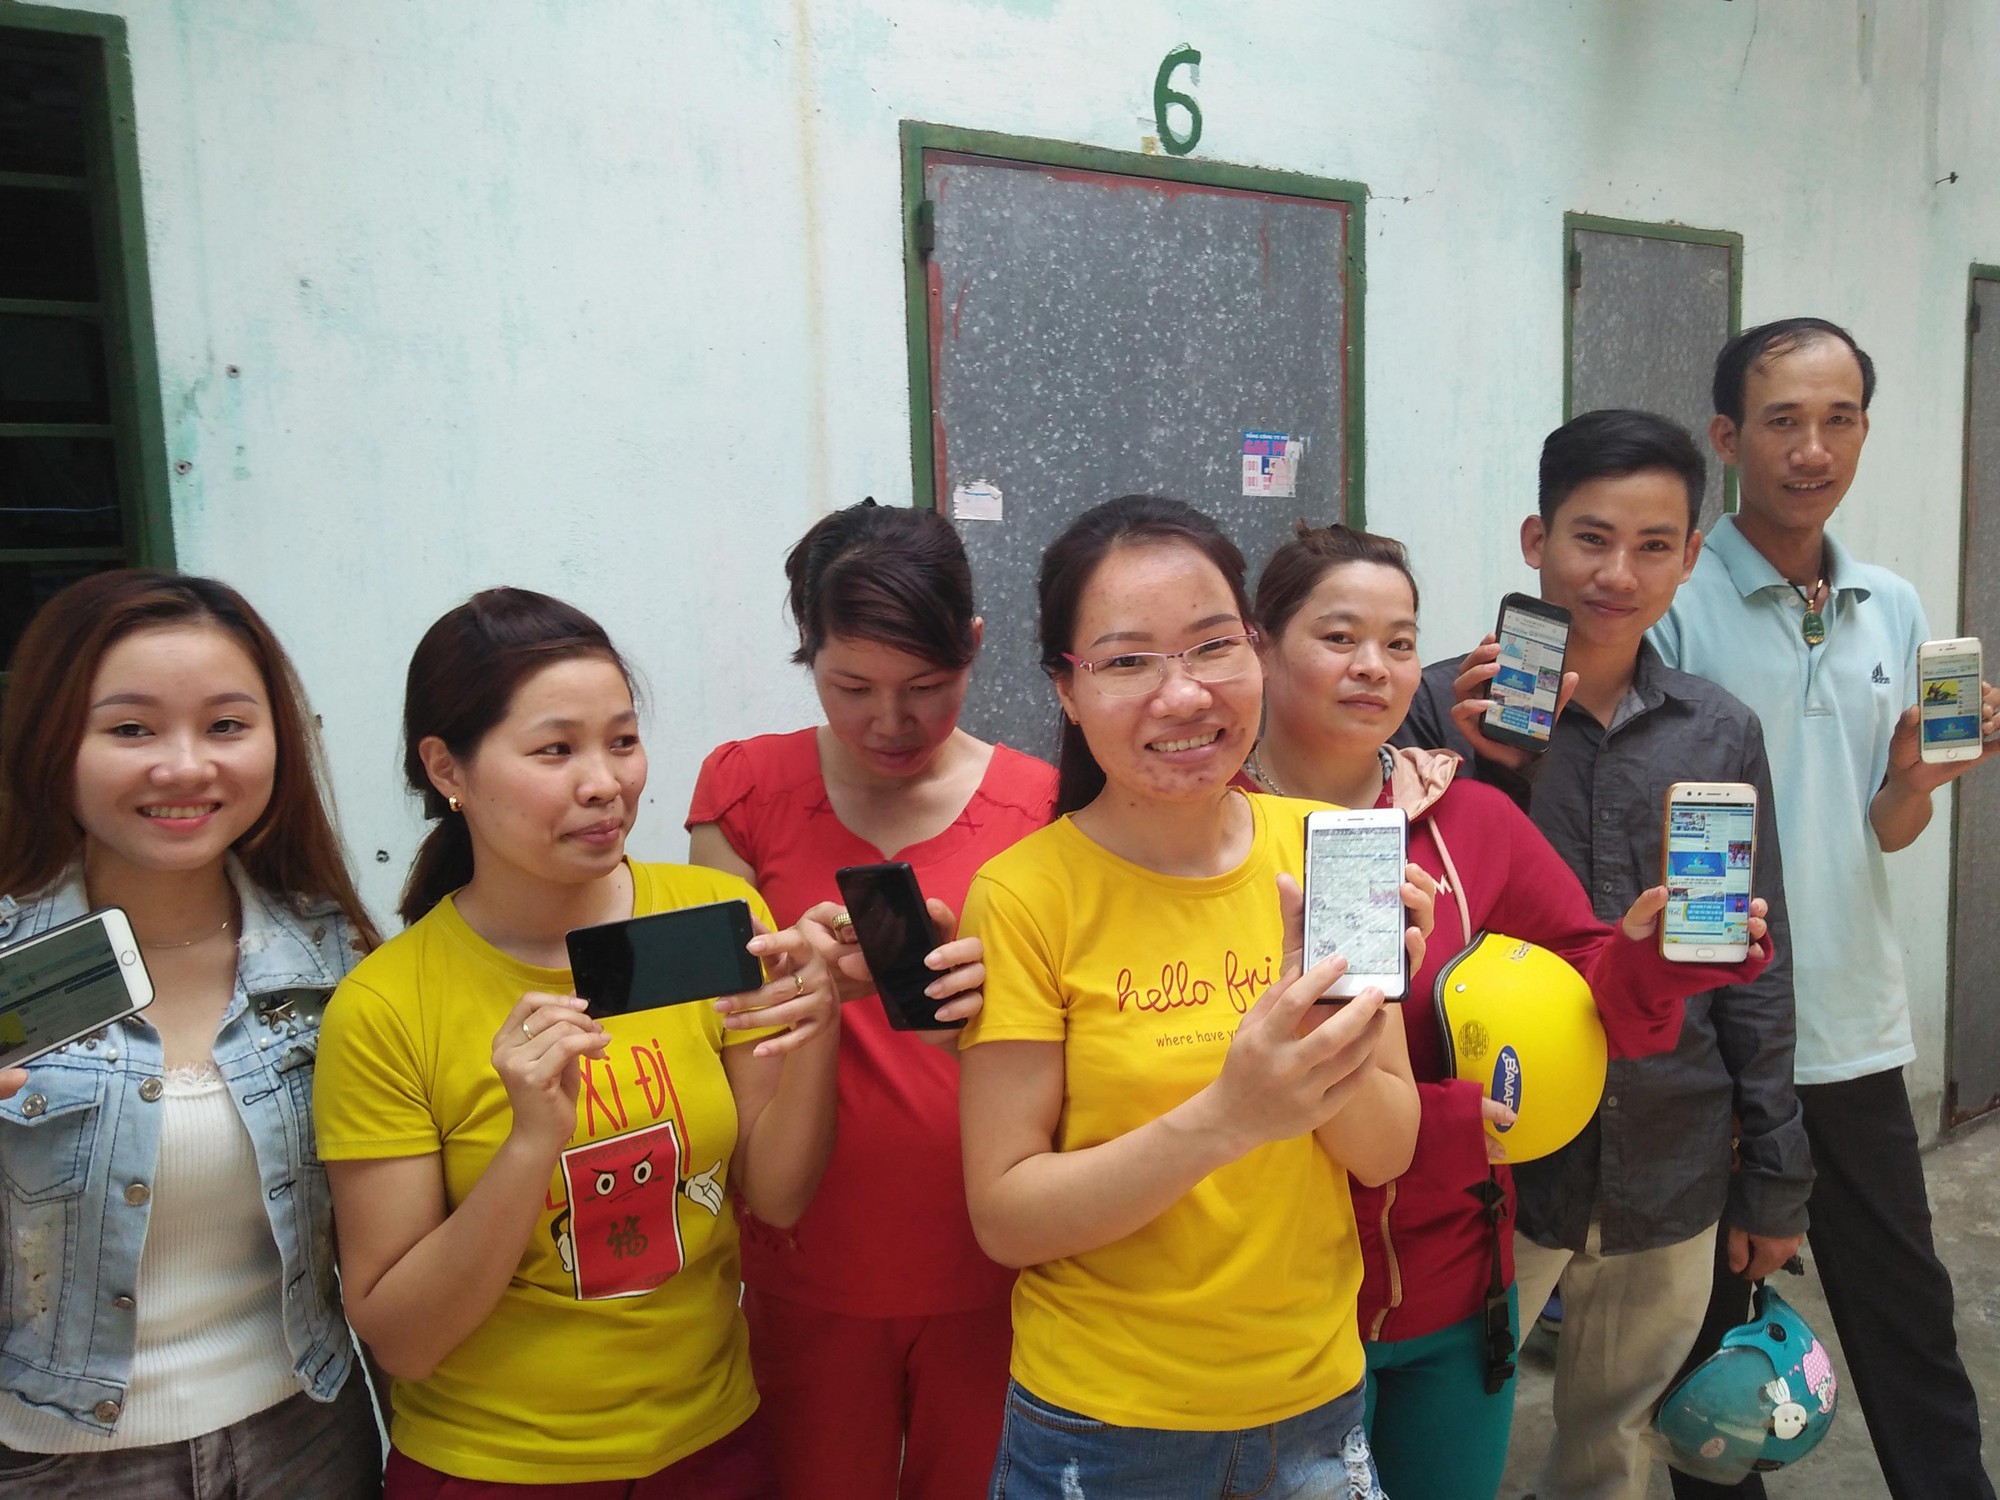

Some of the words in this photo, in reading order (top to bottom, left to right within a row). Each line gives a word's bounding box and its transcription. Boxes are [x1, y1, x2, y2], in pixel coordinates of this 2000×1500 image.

[1154, 43, 1202, 156] 6
[1244, 439, 1269, 455] GAS
[1116, 961, 1216, 1013] hello
[1156, 1033, 1194, 1048] where
[1195, 1029, 1225, 1043] have
